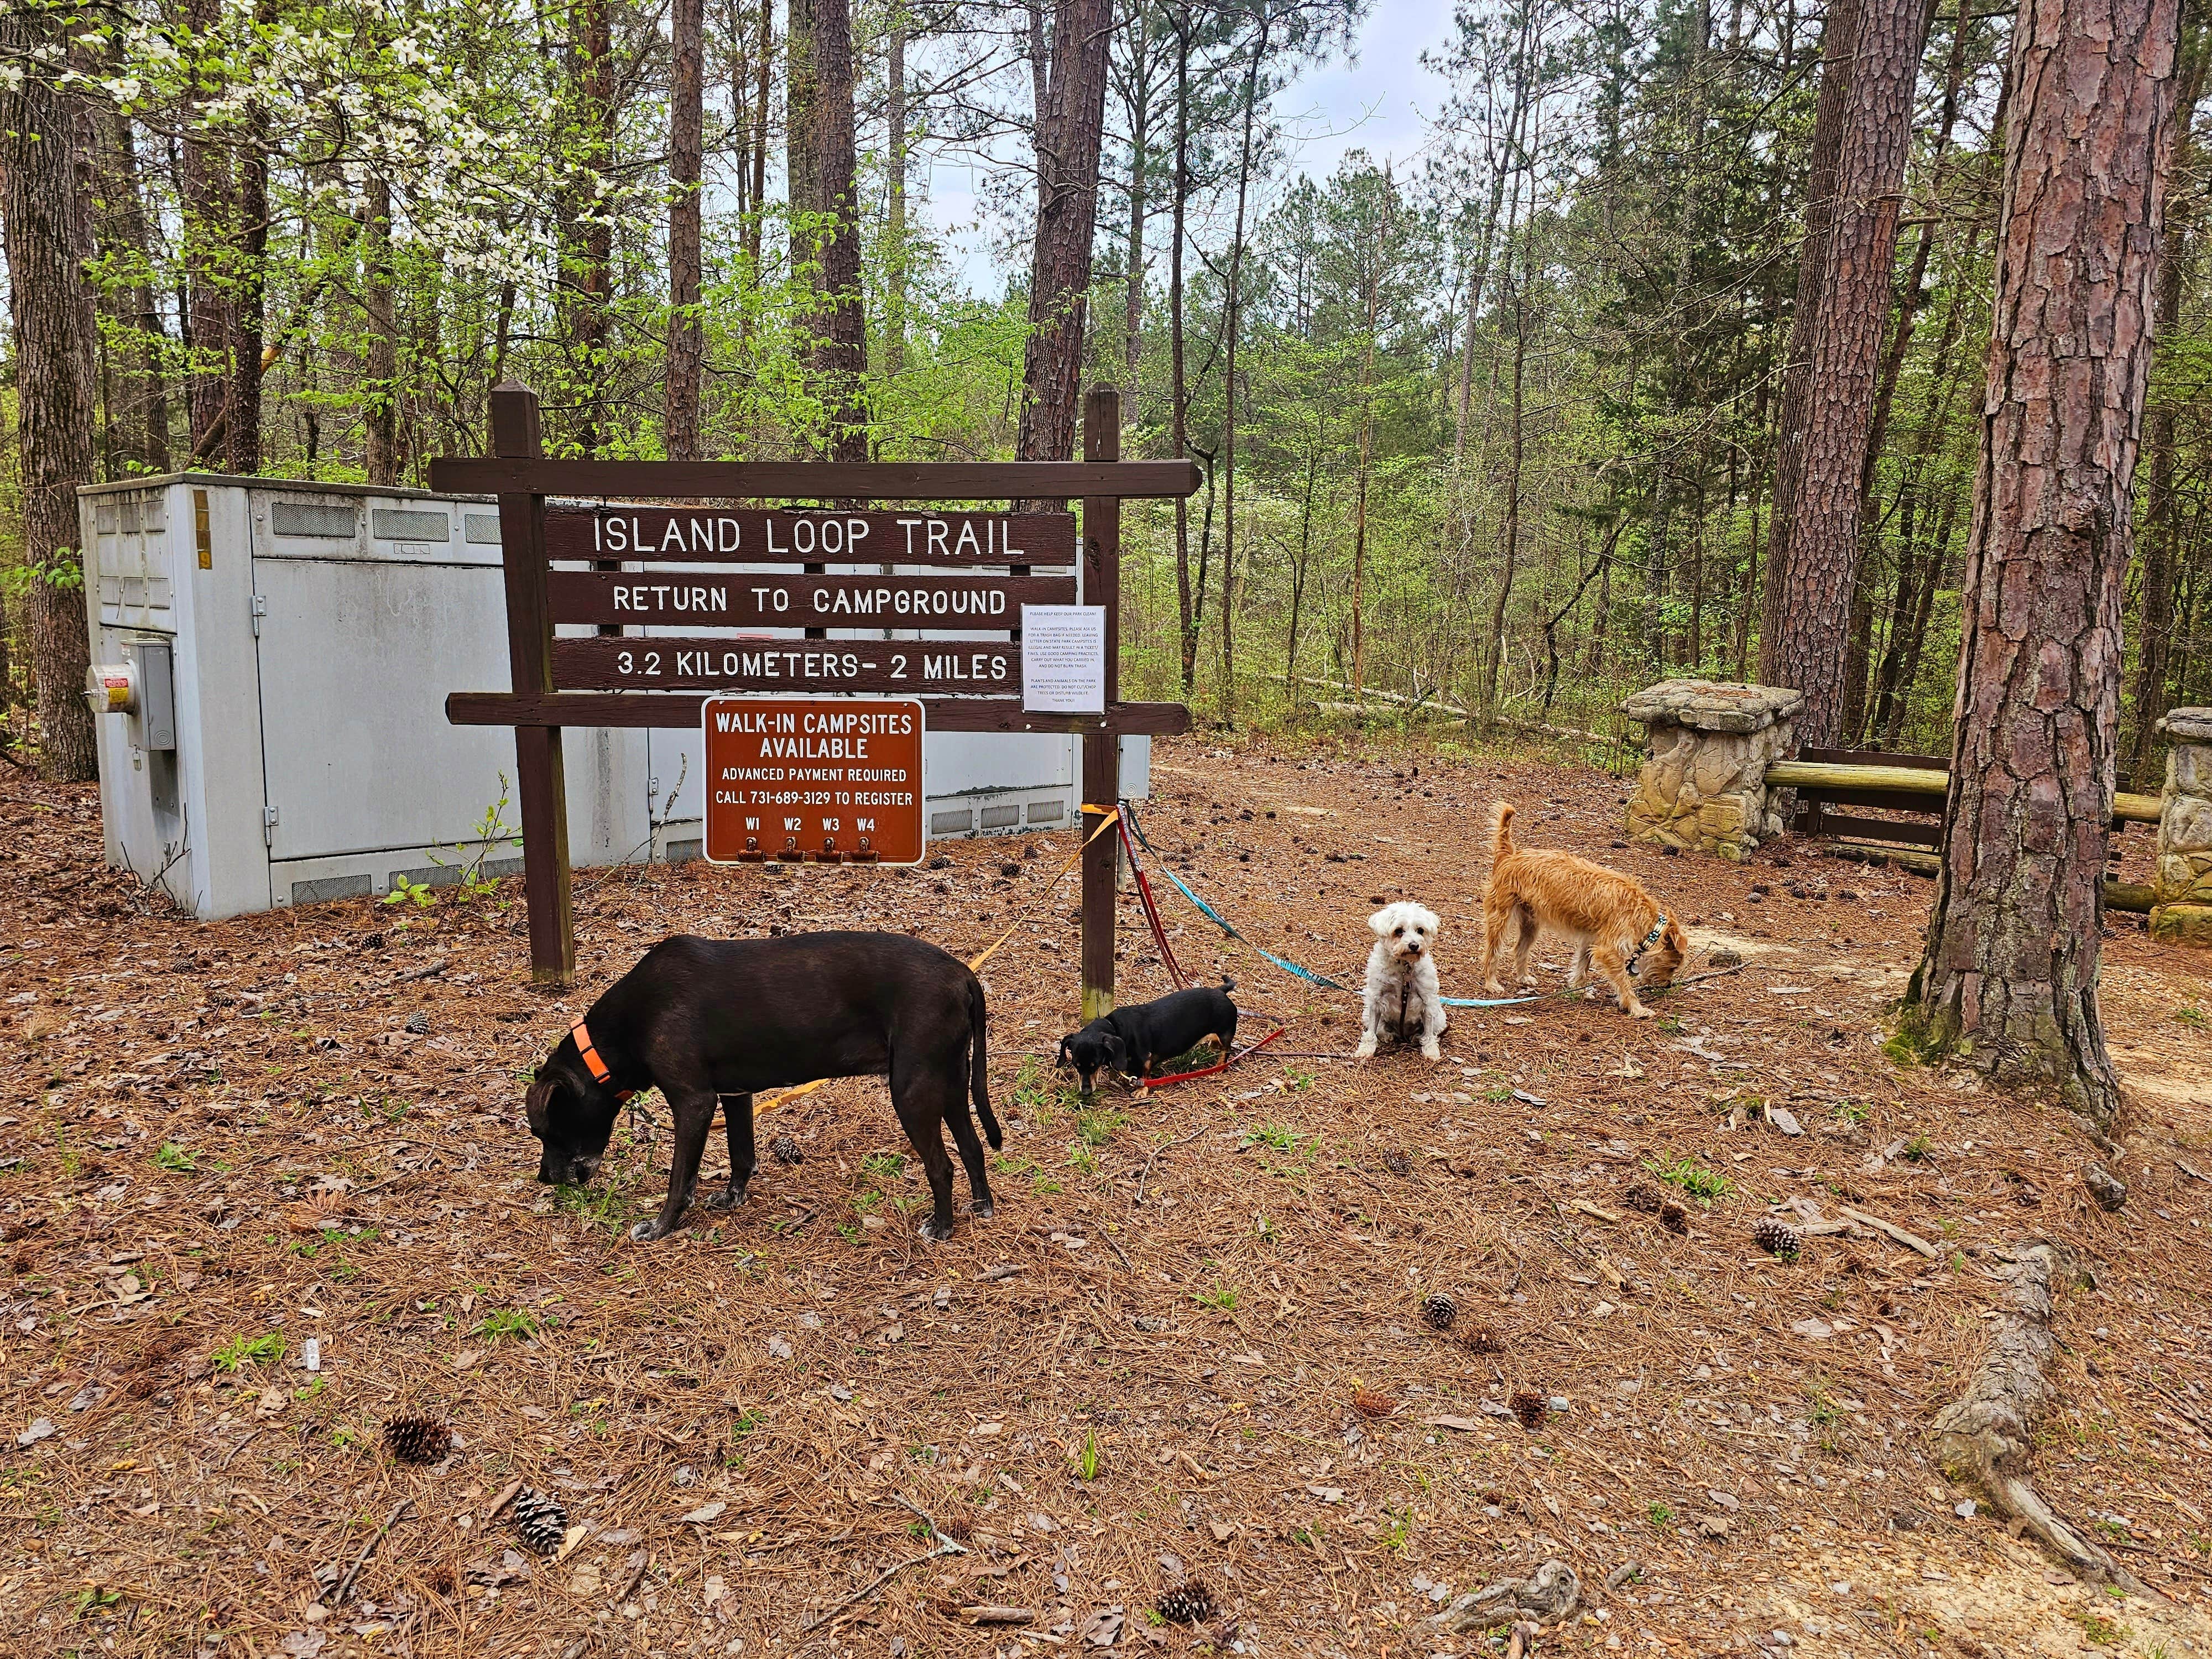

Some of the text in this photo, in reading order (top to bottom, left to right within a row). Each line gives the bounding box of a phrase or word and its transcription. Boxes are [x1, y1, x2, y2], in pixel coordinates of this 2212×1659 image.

[595, 518, 1024, 555] ISLAND LOOP TRAIL
[614, 586, 1005, 614] RETURN TO CAMPGROUND
[618, 651, 661, 675] 3.2
[890, 655, 906, 678] 2
[924, 654, 1006, 679] MILES
[716, 713, 911, 734] WALK-IN CAMPSITES
[760, 738, 868, 758] AVAILABLE
[722, 768, 906, 781] ADVANCED PAYMENT REQUIRED
[716, 791, 912, 805] CALL 731-689-3129 TO REGISTER
[746, 817, 874, 831] W1 W2 W3 W4
